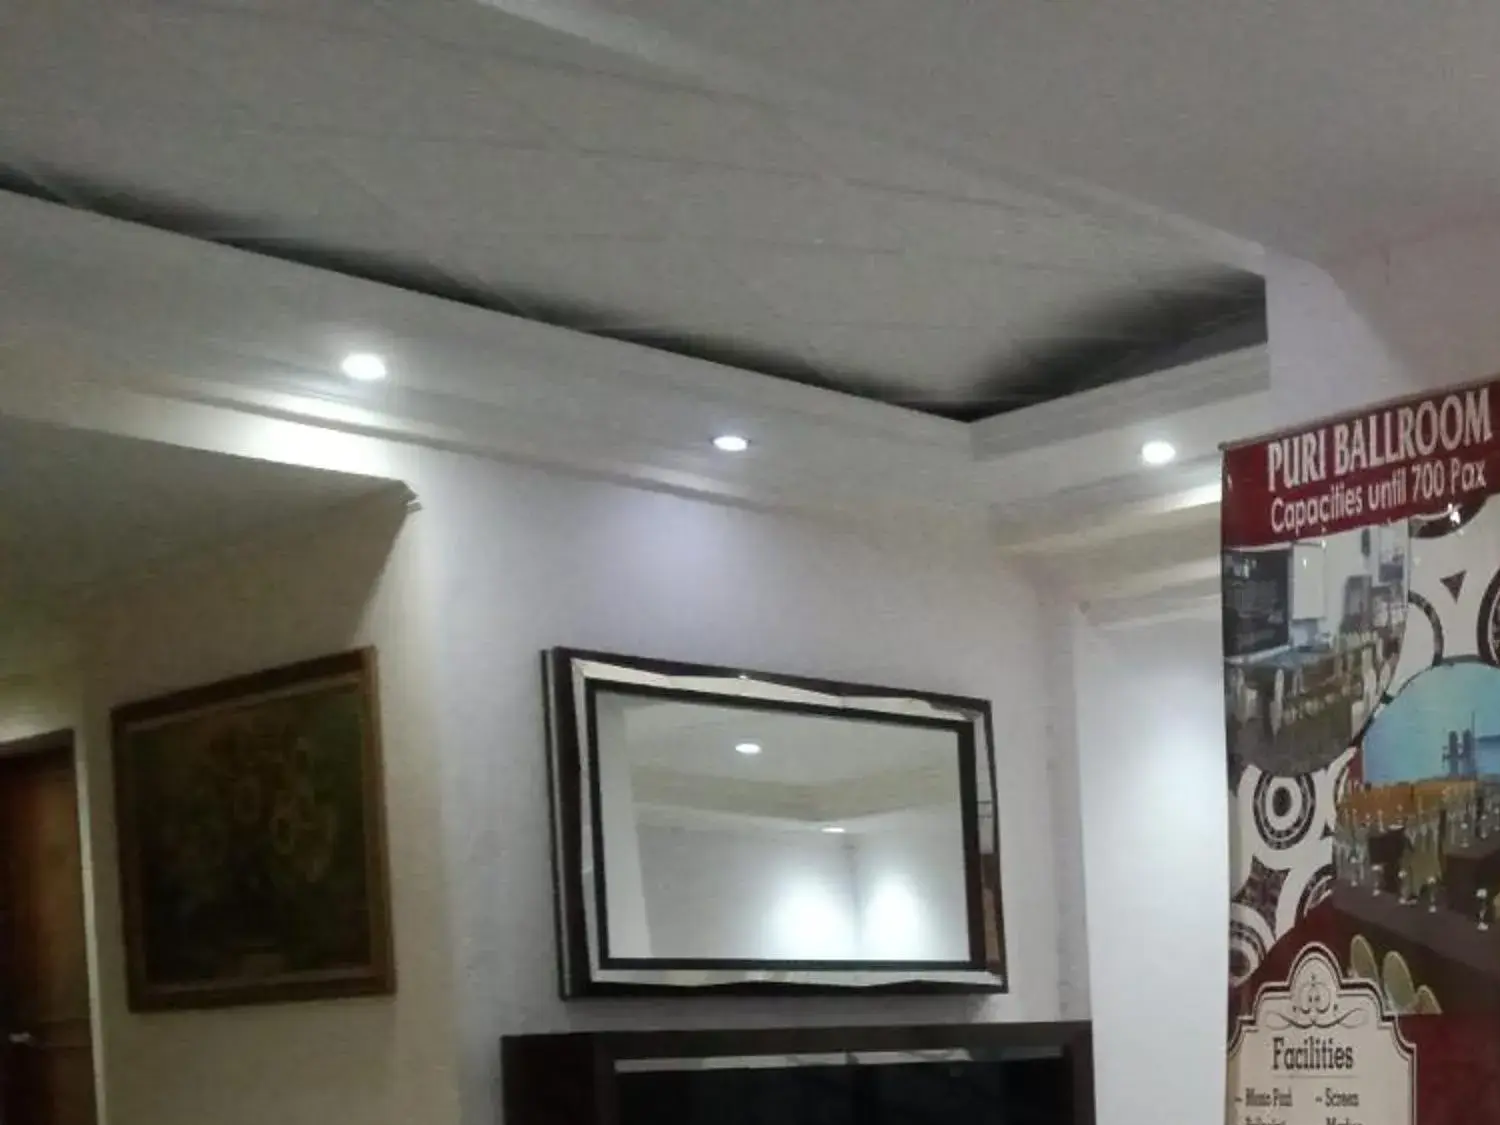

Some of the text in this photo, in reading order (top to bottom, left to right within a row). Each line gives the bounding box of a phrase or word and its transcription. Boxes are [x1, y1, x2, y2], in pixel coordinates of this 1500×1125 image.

[1267, 387, 1493, 492] PURI BALLROOM
[1270, 456, 1488, 538] Capacities until 700 Pax
[1272, 1035, 1354, 1070] Facilities
[1325, 1087, 1359, 1107] Screen
